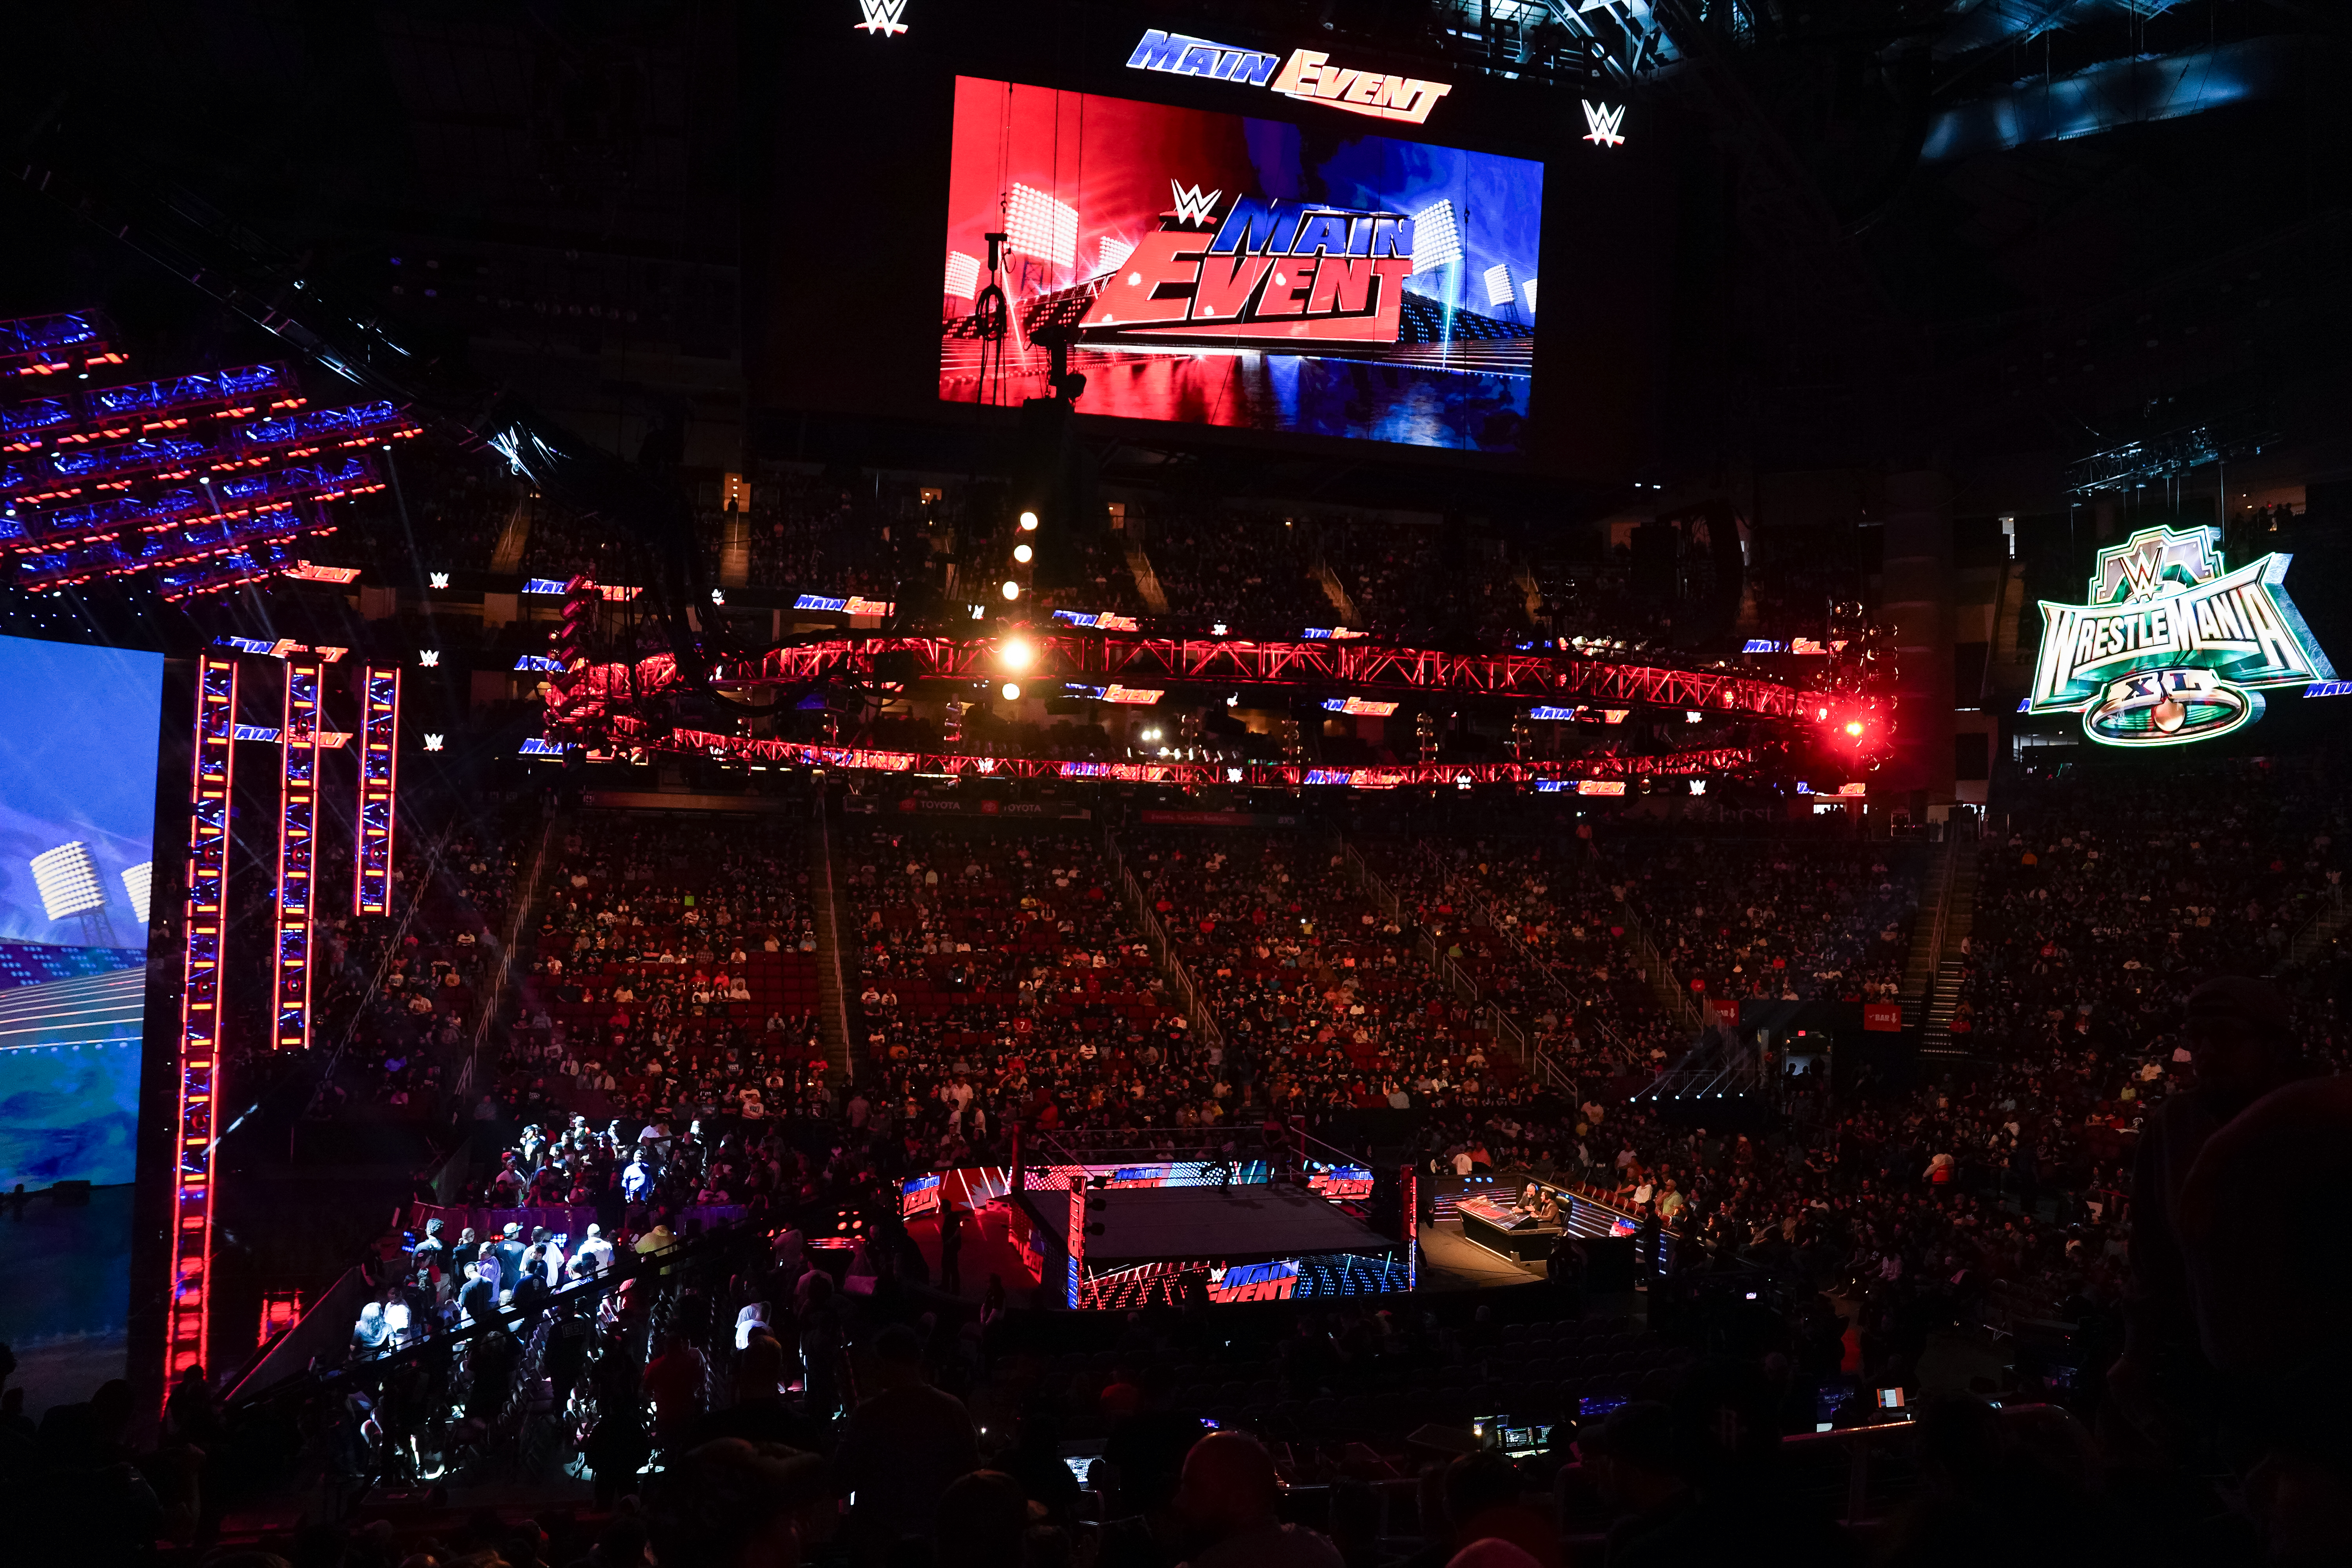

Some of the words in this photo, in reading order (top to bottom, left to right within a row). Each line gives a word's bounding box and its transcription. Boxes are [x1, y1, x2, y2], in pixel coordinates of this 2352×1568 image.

[1126, 29, 1280, 86] MAIN
[1270, 49, 1452, 124] EVENT
[1209, 193, 1415, 258] MAIN
[1079, 231, 1413, 343] EVENT
[793, 594, 846, 611] MAIN
[1102, 684, 1164, 704] EVENT
[2123, 673, 2201, 701] XL
[1342, 697, 1399, 716] EVENT
[920, 800, 960, 809] TOYOTA
[903, 1186, 939, 1216] VENT
[1220, 1260, 1299, 1290] MAIN
